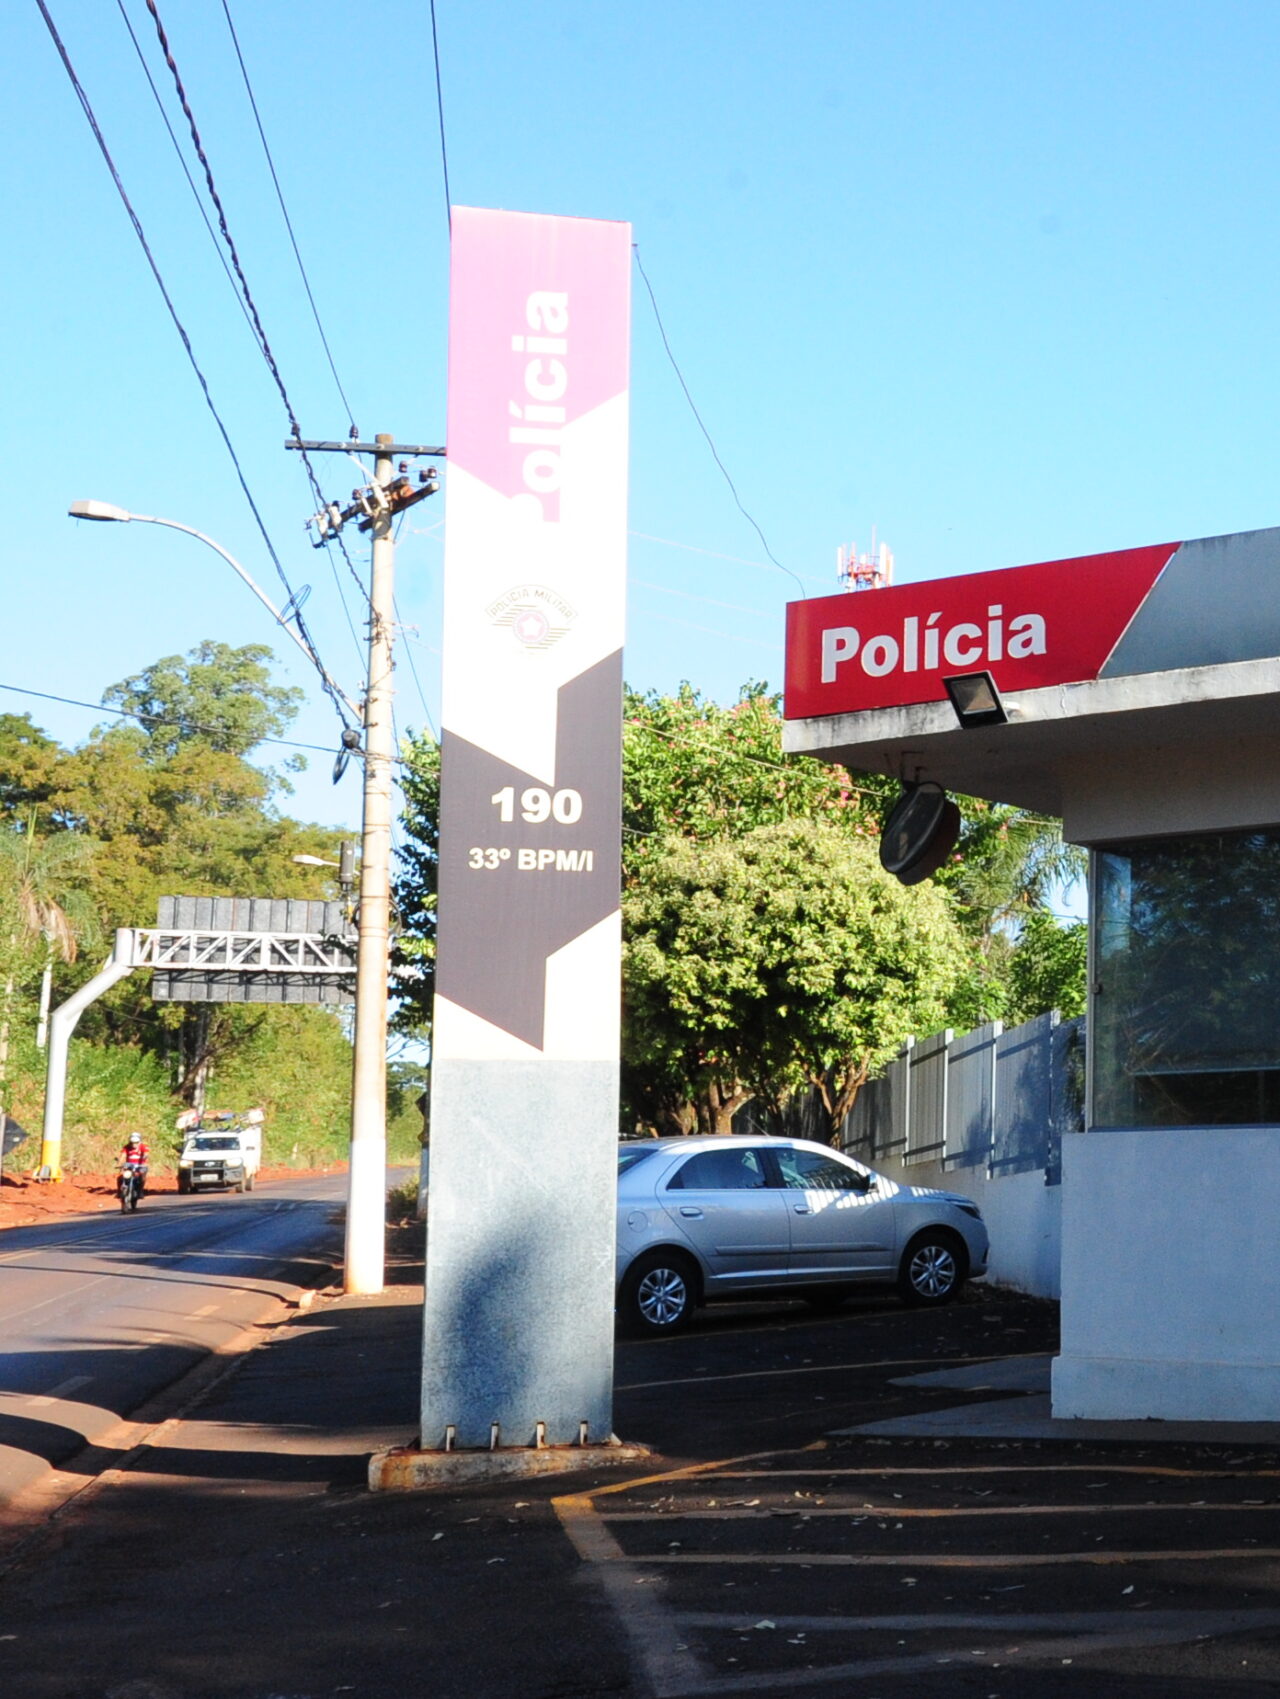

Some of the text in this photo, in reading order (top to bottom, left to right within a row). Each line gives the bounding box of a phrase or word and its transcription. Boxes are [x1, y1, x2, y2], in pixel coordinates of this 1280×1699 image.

[821, 604, 1047, 684] Polícia
[491, 786, 583, 825] 190
[517, 848, 594, 872] BPM/I
